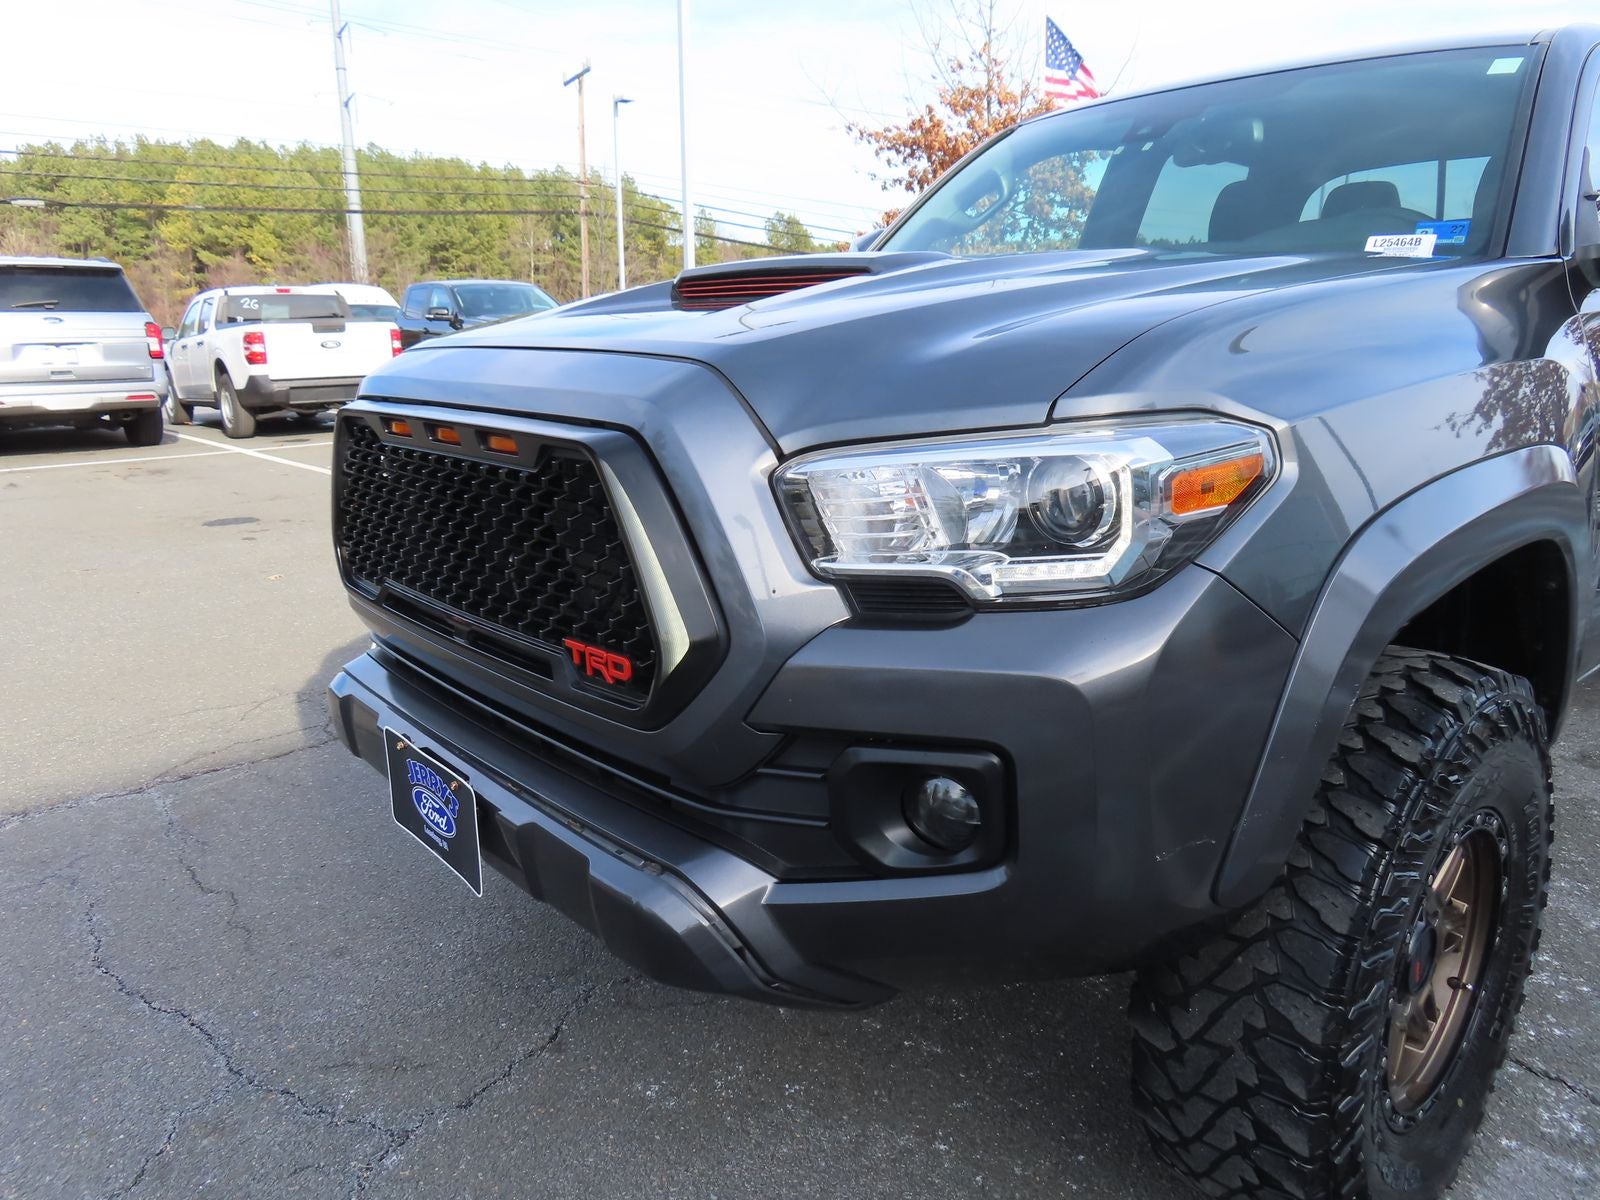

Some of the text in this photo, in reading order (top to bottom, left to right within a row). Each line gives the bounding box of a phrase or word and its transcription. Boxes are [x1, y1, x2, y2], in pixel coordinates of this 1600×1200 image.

[1373, 237, 1422, 248] L25464B
[1450, 225, 1465, 234] 27
[564, 638, 632, 683] TRD
[406, 759, 459, 818] JERRY'S
[420, 793, 448, 831] Ford
